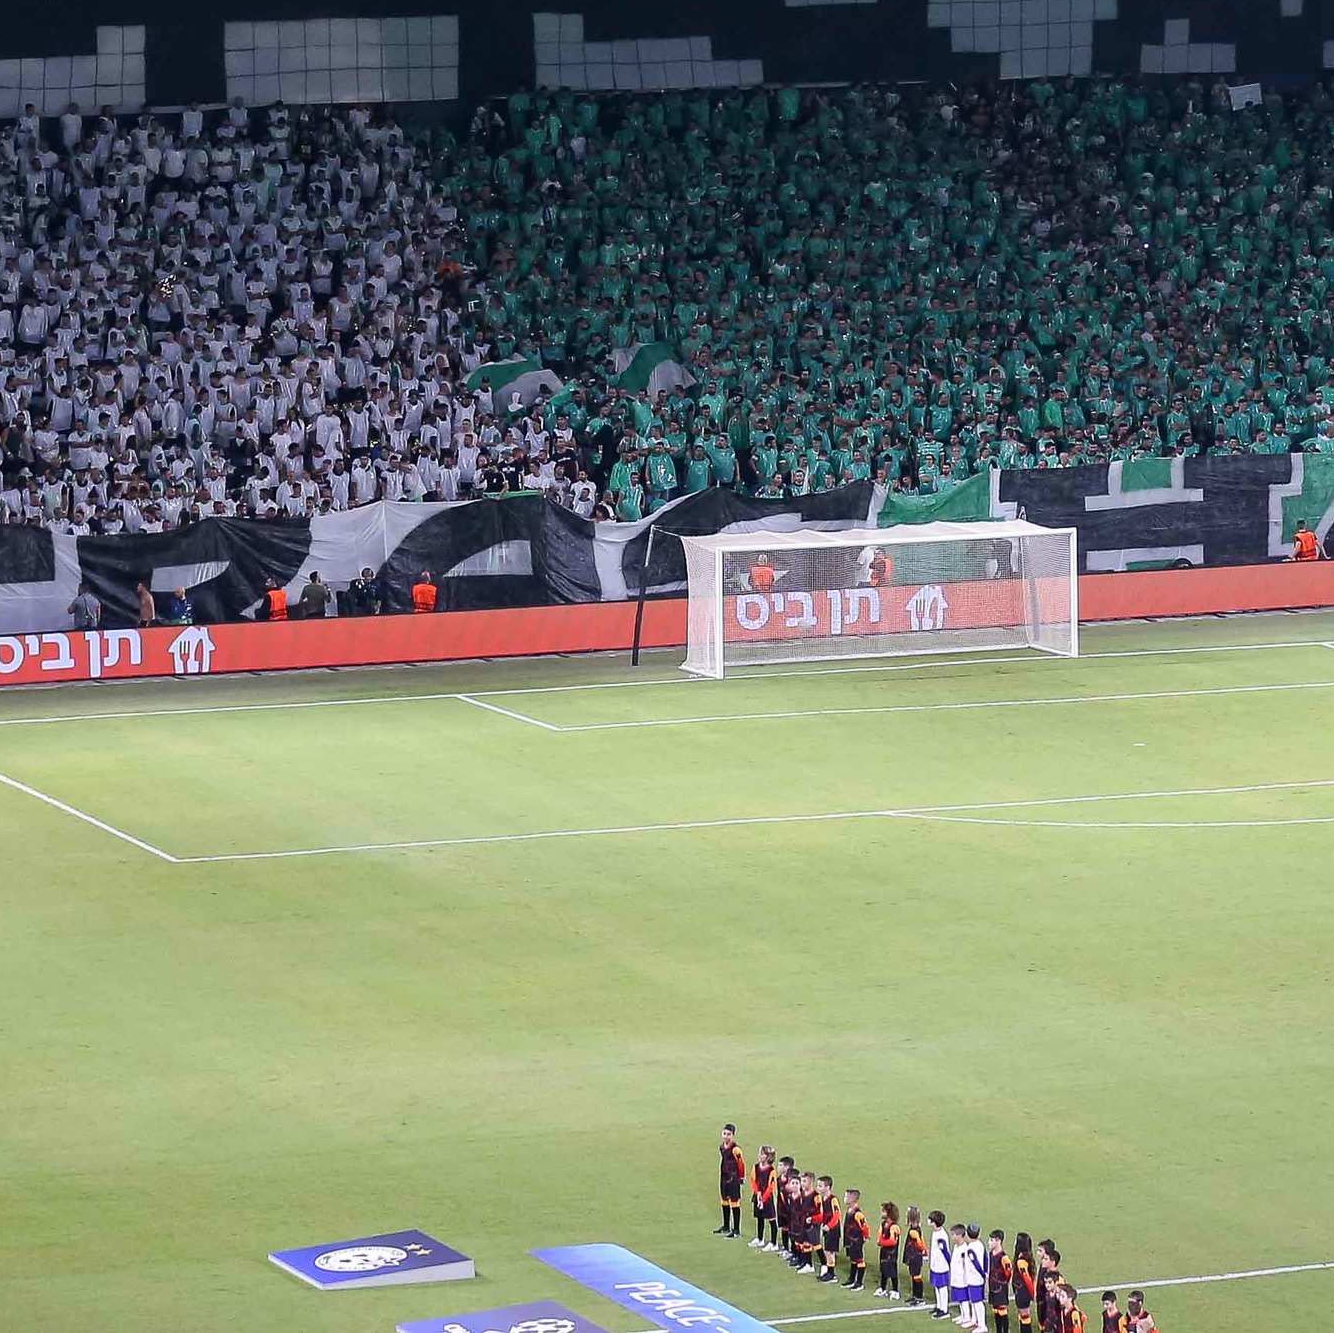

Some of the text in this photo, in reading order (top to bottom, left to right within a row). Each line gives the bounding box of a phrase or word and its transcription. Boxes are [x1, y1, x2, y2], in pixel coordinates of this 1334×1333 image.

[736, 588, 881, 635] תן ביס
[84, 629, 142, 678] תן
[613, 1281, 731, 1327] PEACE
